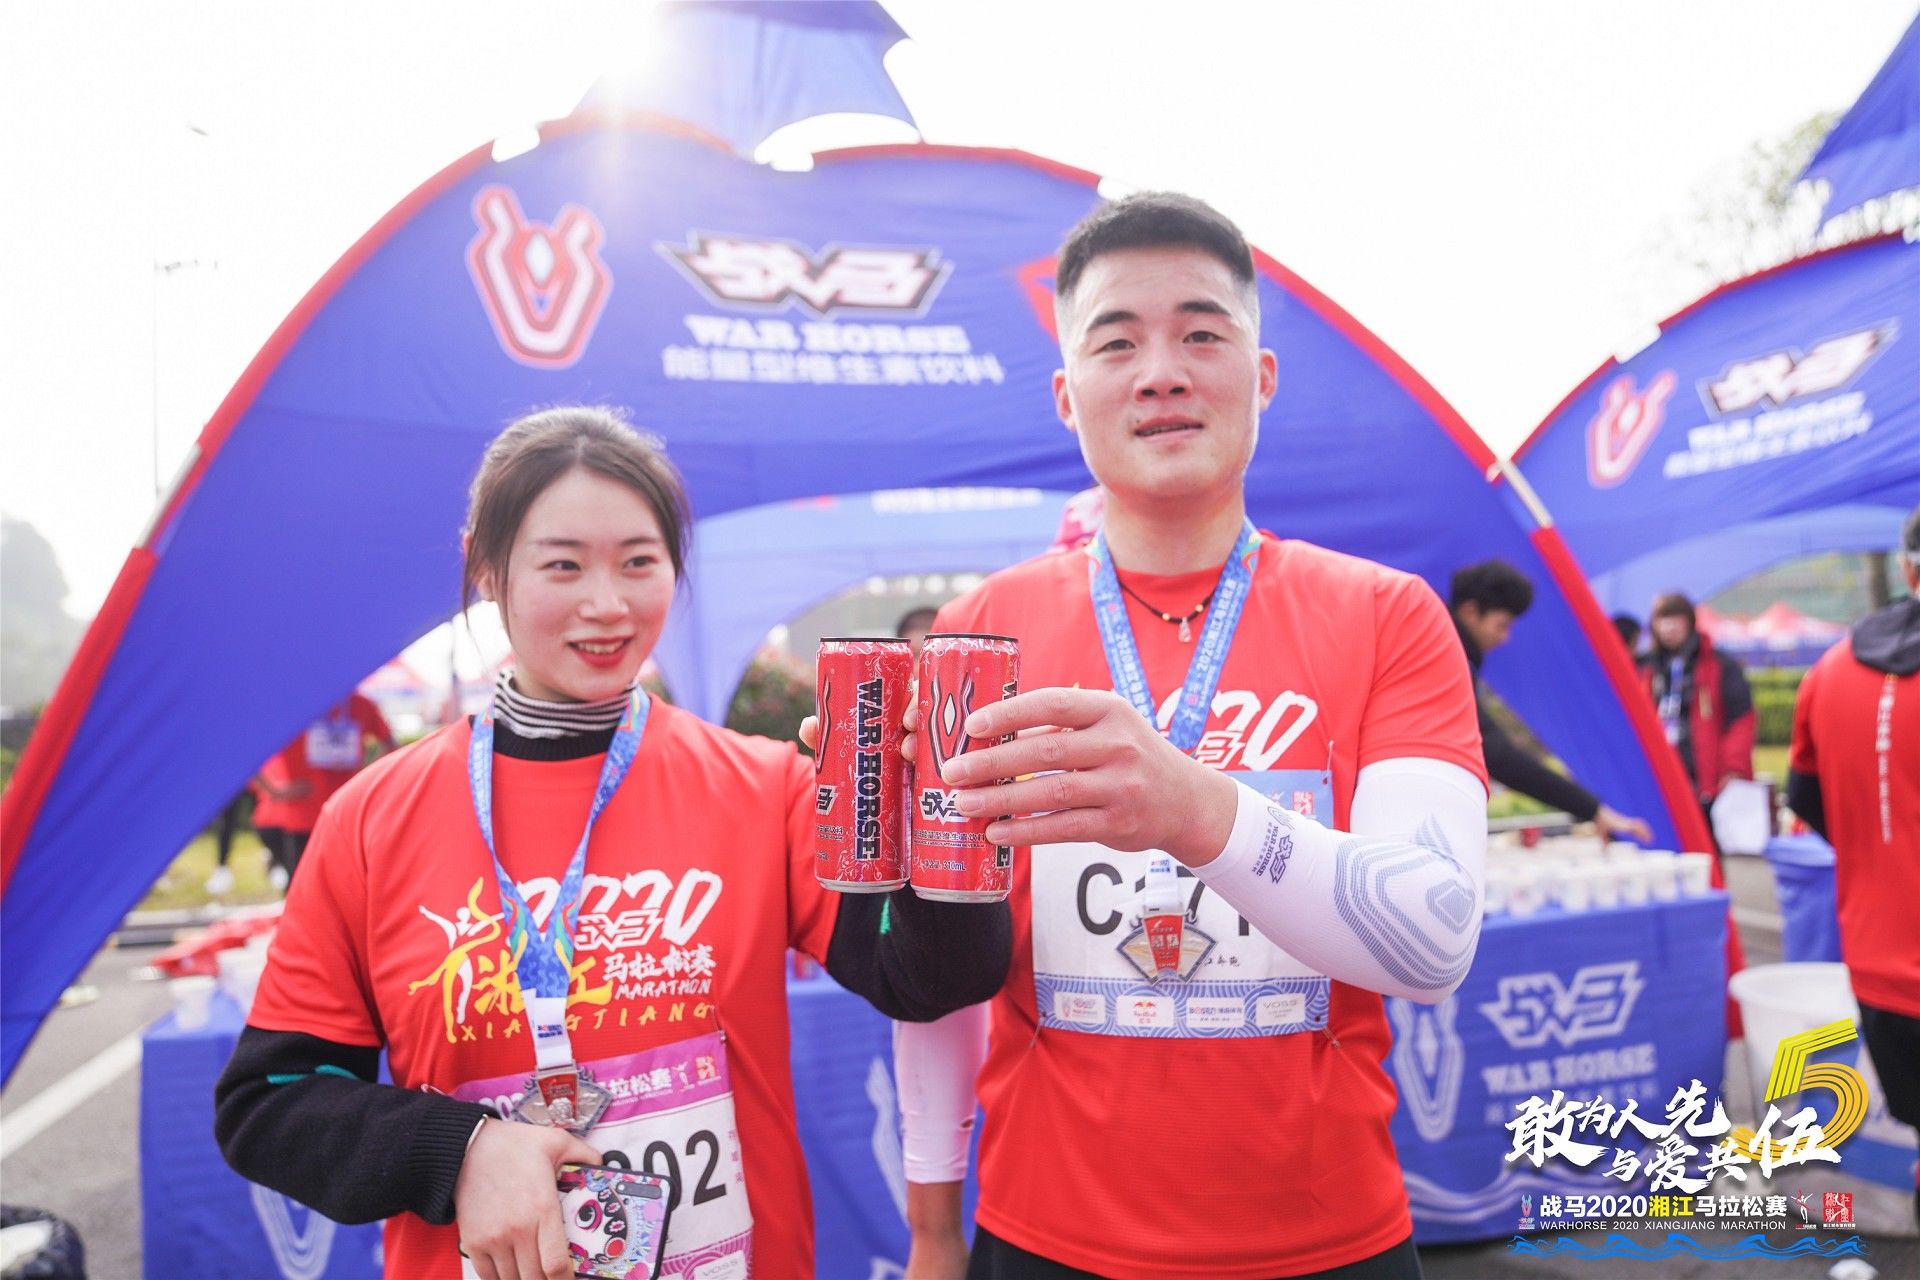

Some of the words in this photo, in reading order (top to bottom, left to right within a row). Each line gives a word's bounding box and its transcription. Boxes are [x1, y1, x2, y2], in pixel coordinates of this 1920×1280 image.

[684, 314, 801, 350] WAR
[801, 321, 972, 355] HORSE
[856, 678, 884, 747] WAR
[854, 751, 884, 862] HORSE
[1256, 845, 1275, 877] HORSE
[602, 942, 717, 983] 马拉松赛
[614, 978, 712, 1000] MARATHON
[1478, 959, 1648, 1048] 战马
[461, 1002, 713, 1043] XIAGJIANG
[598, 1067, 673, 1099] 拉松赛
[1482, 1059, 1549, 1096] WAR
[1553, 1043, 1658, 1088] HORSE
